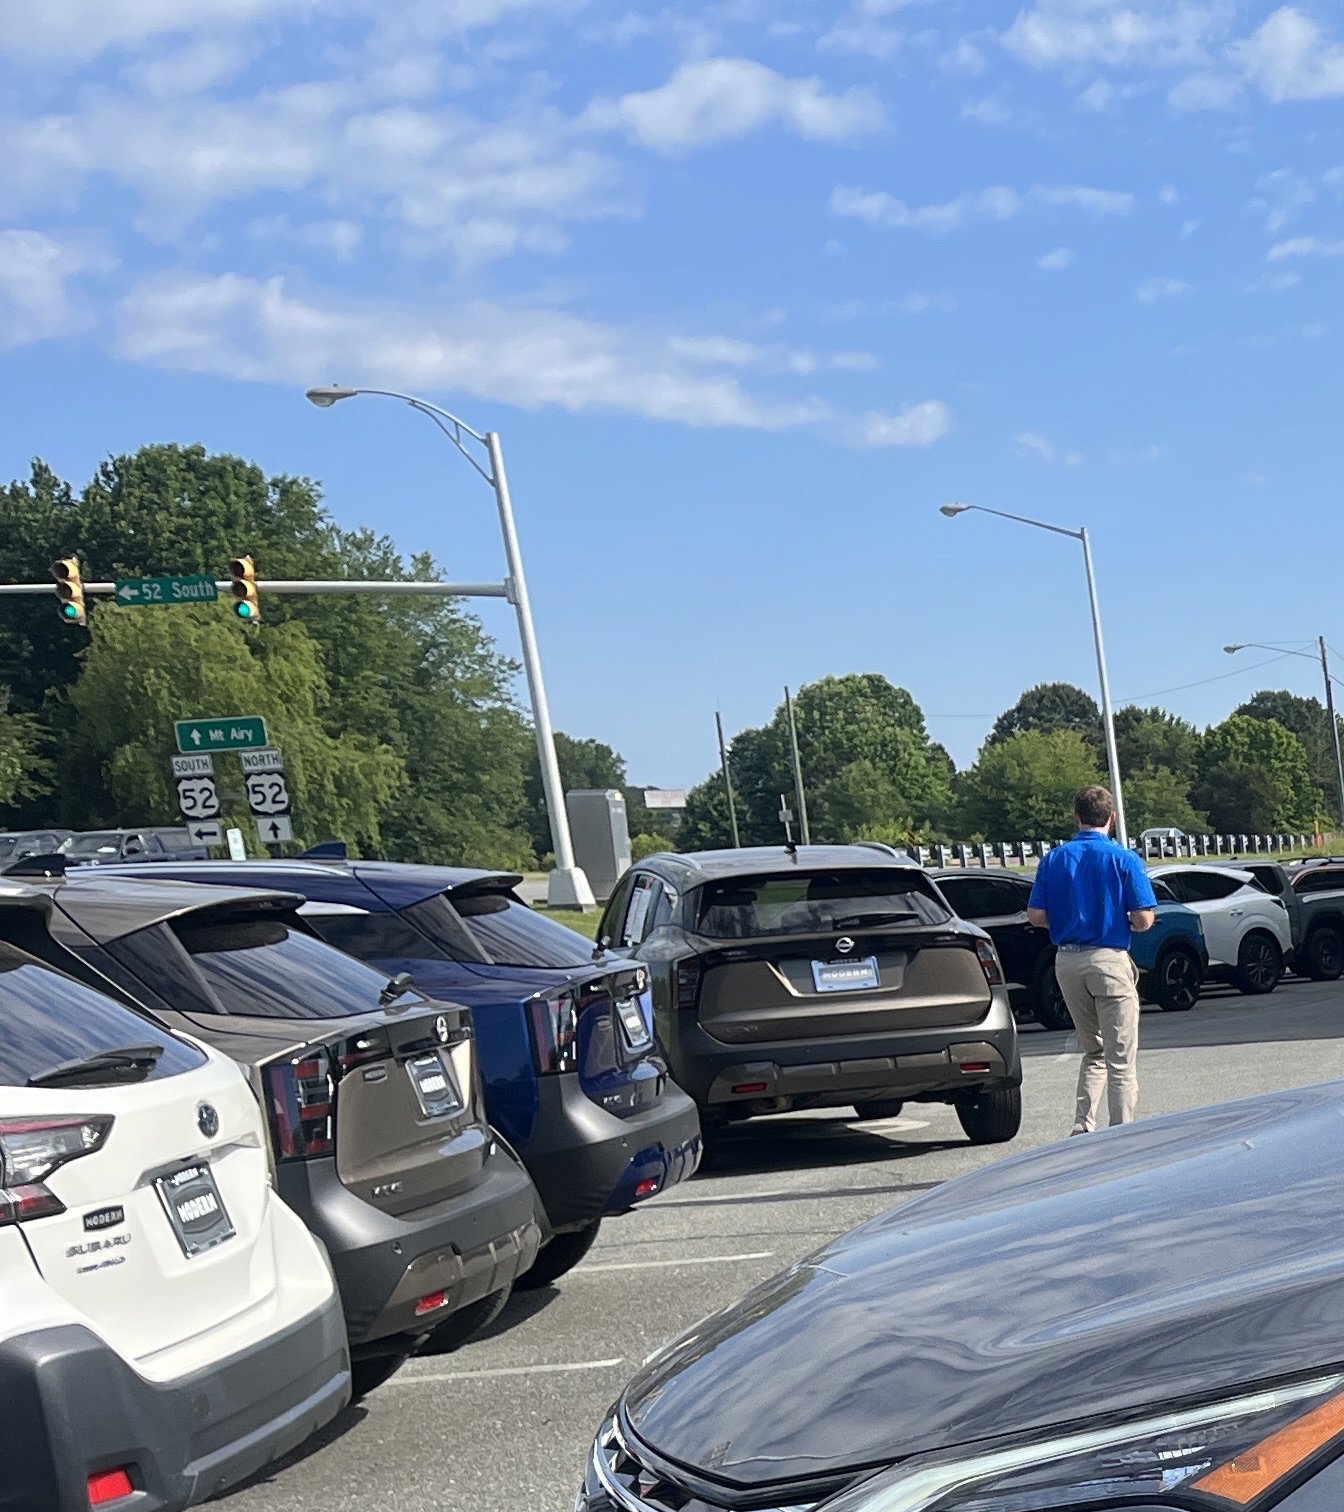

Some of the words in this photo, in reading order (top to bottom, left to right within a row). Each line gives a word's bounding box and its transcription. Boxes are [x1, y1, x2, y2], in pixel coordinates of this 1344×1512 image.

[142, 583, 162, 600] 52
[171, 581, 215, 599] South
[208, 729, 225, 741] Mt
[230, 727, 254, 742] Airy
[174, 758, 209, 772] SOUTH
[243, 754, 279, 767] NORTH
[182, 787, 216, 811] 52
[252, 782, 286, 806] 52
[177, 1192, 218, 1223] MODERN
[85, 1209, 123, 1228] MODERN
[66, 1233, 132, 1258] SUBARU
